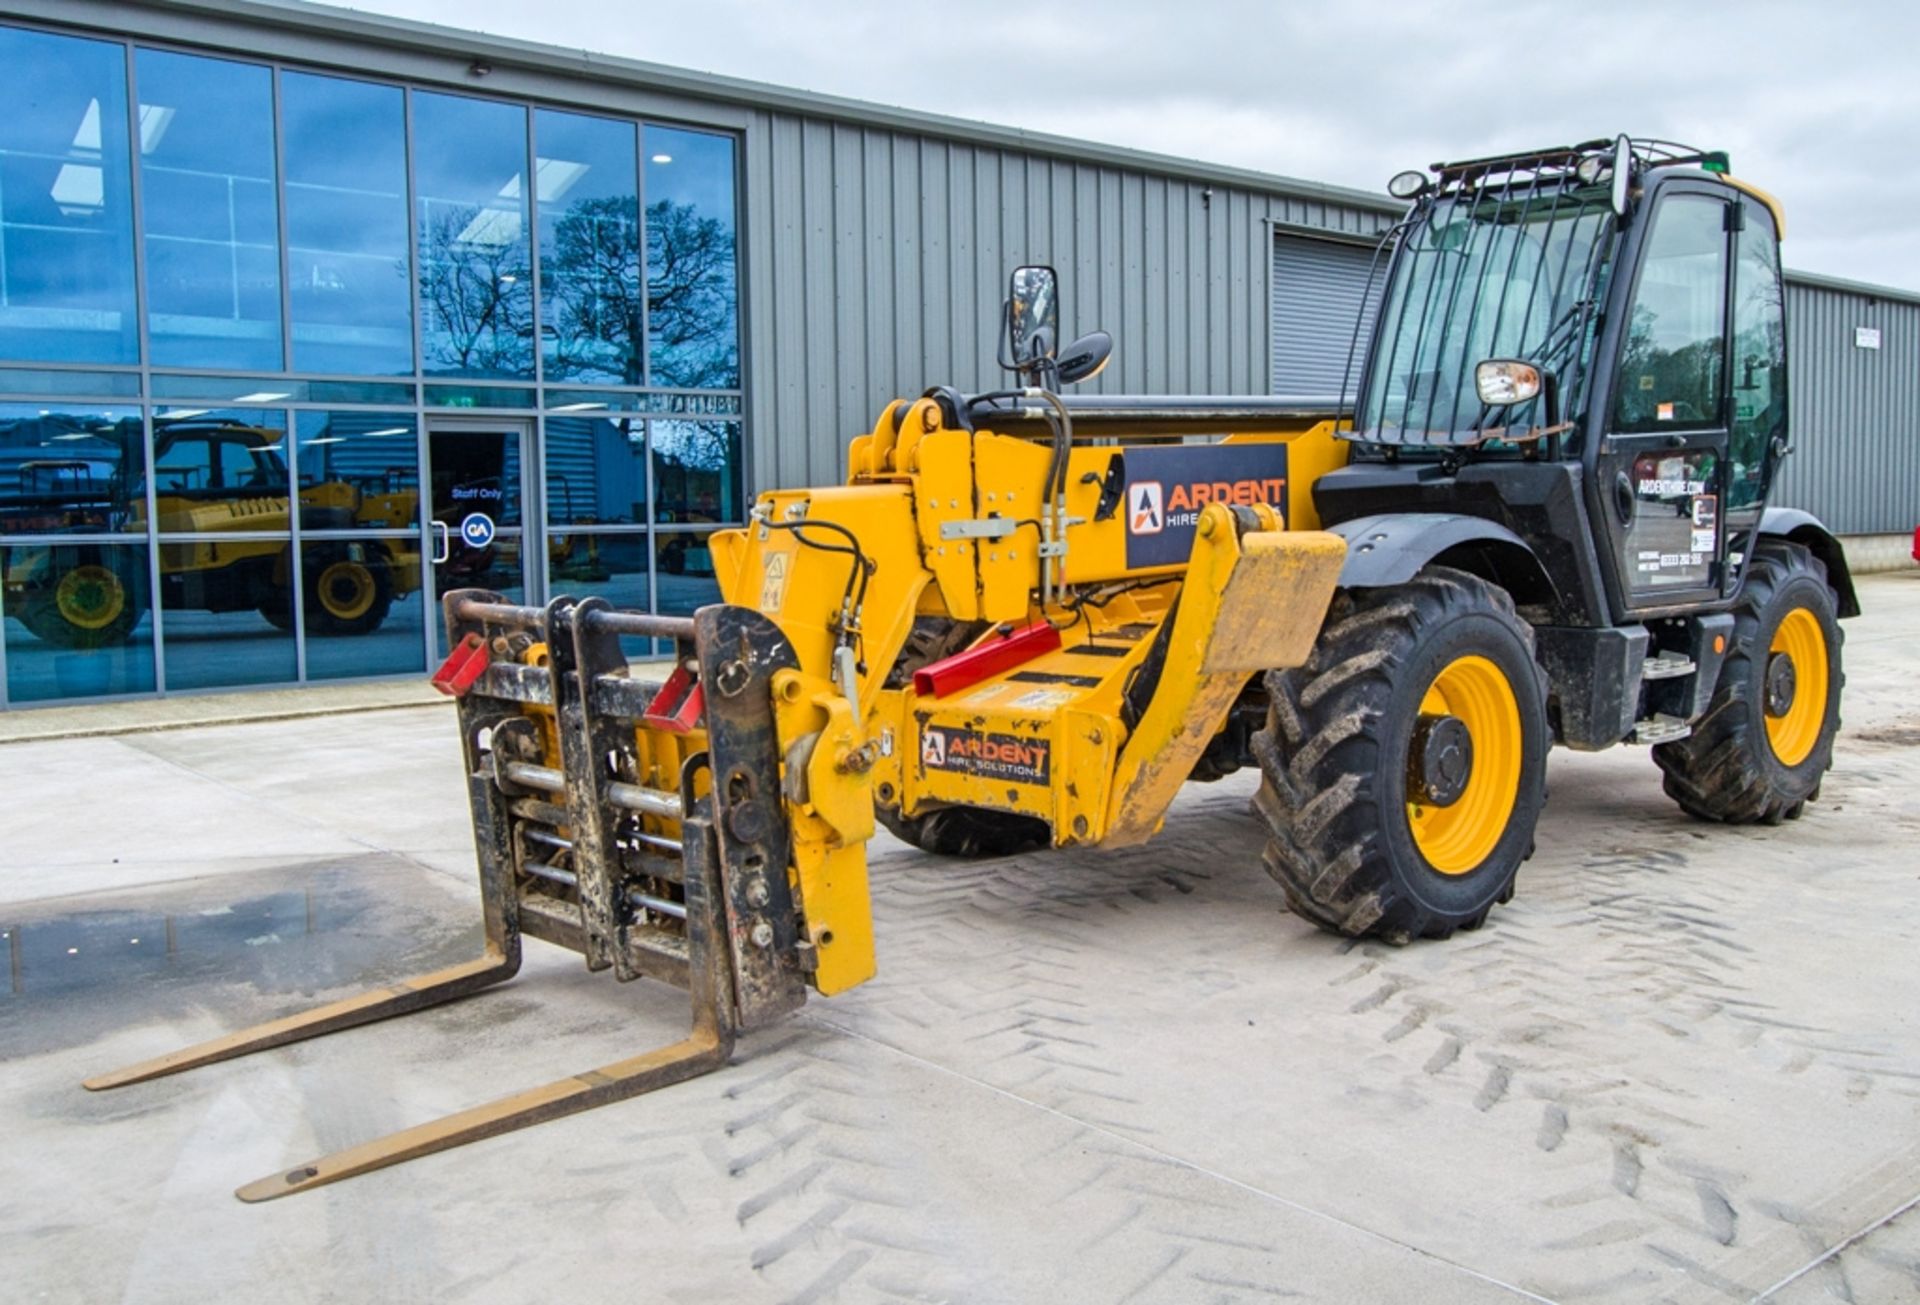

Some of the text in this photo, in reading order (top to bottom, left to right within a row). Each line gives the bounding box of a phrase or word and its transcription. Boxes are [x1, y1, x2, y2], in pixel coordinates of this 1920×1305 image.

[451, 488, 502, 500] Staff Only
[1167, 479, 1285, 511] ARDENT
[1166, 512, 1199, 527] HIRE
[949, 736, 1046, 766] ARDENT
